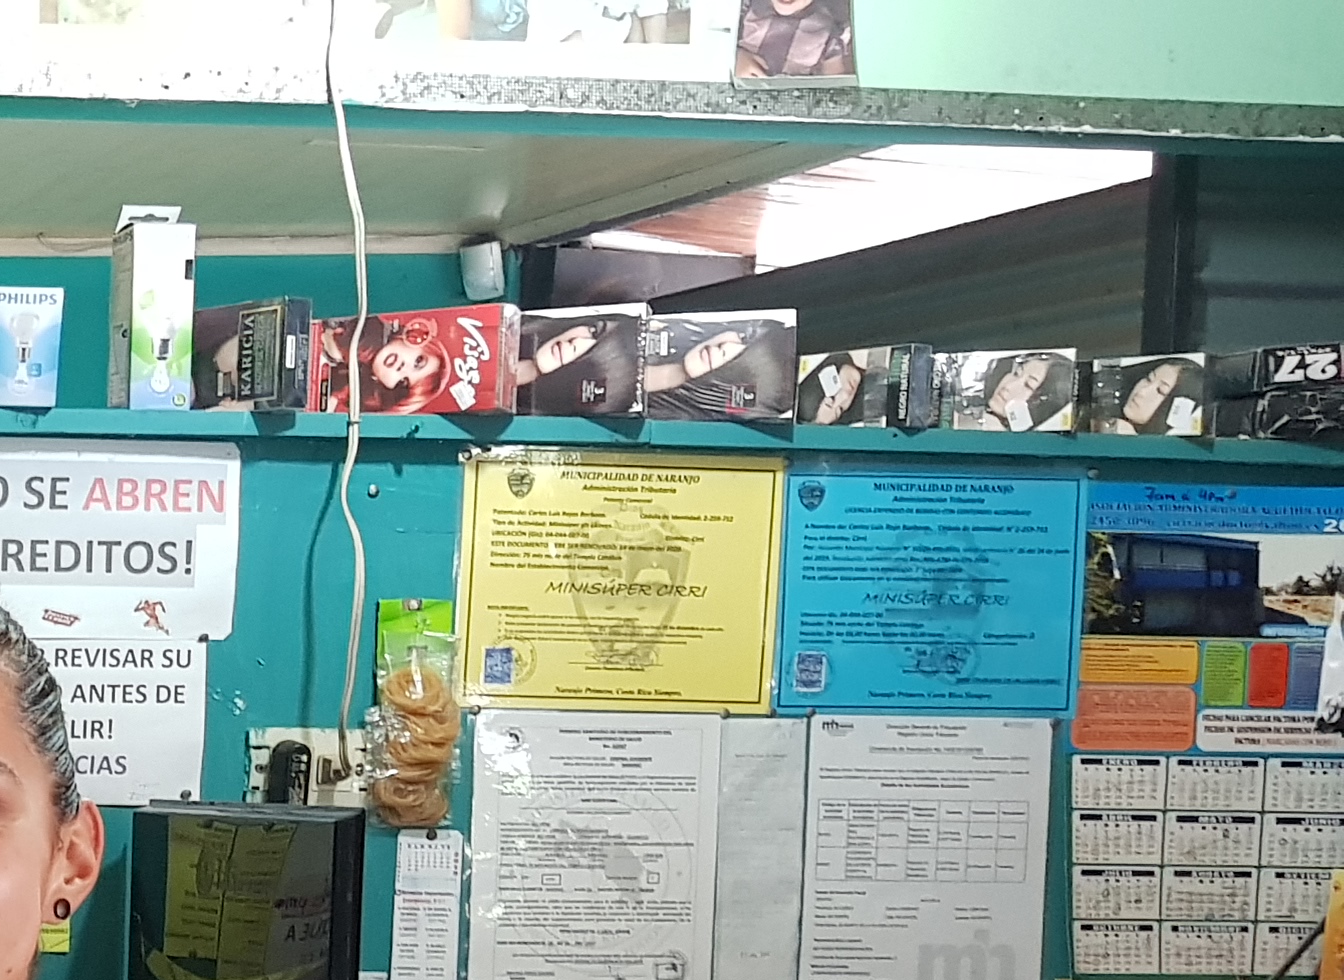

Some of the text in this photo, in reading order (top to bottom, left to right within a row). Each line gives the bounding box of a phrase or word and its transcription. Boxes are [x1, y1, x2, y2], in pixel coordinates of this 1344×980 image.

[239, 315, 255, 397] KARICIA
[1272, 352, 1340, 384] 27
[560, 470, 701, 485] MUNICIPALIDAD DE NARANJO
[872, 482, 953, 493] MUNICIPALIDAD
[954, 484, 968, 493] DE
[23, 476, 70, 510] SE
[82, 477, 226, 513] ABREN
[544, 578, 708, 598] MINISÚPER CIRRI
[54, 648, 192, 669] REVISAR SU
[70, 684, 186, 704] ANTES DE
